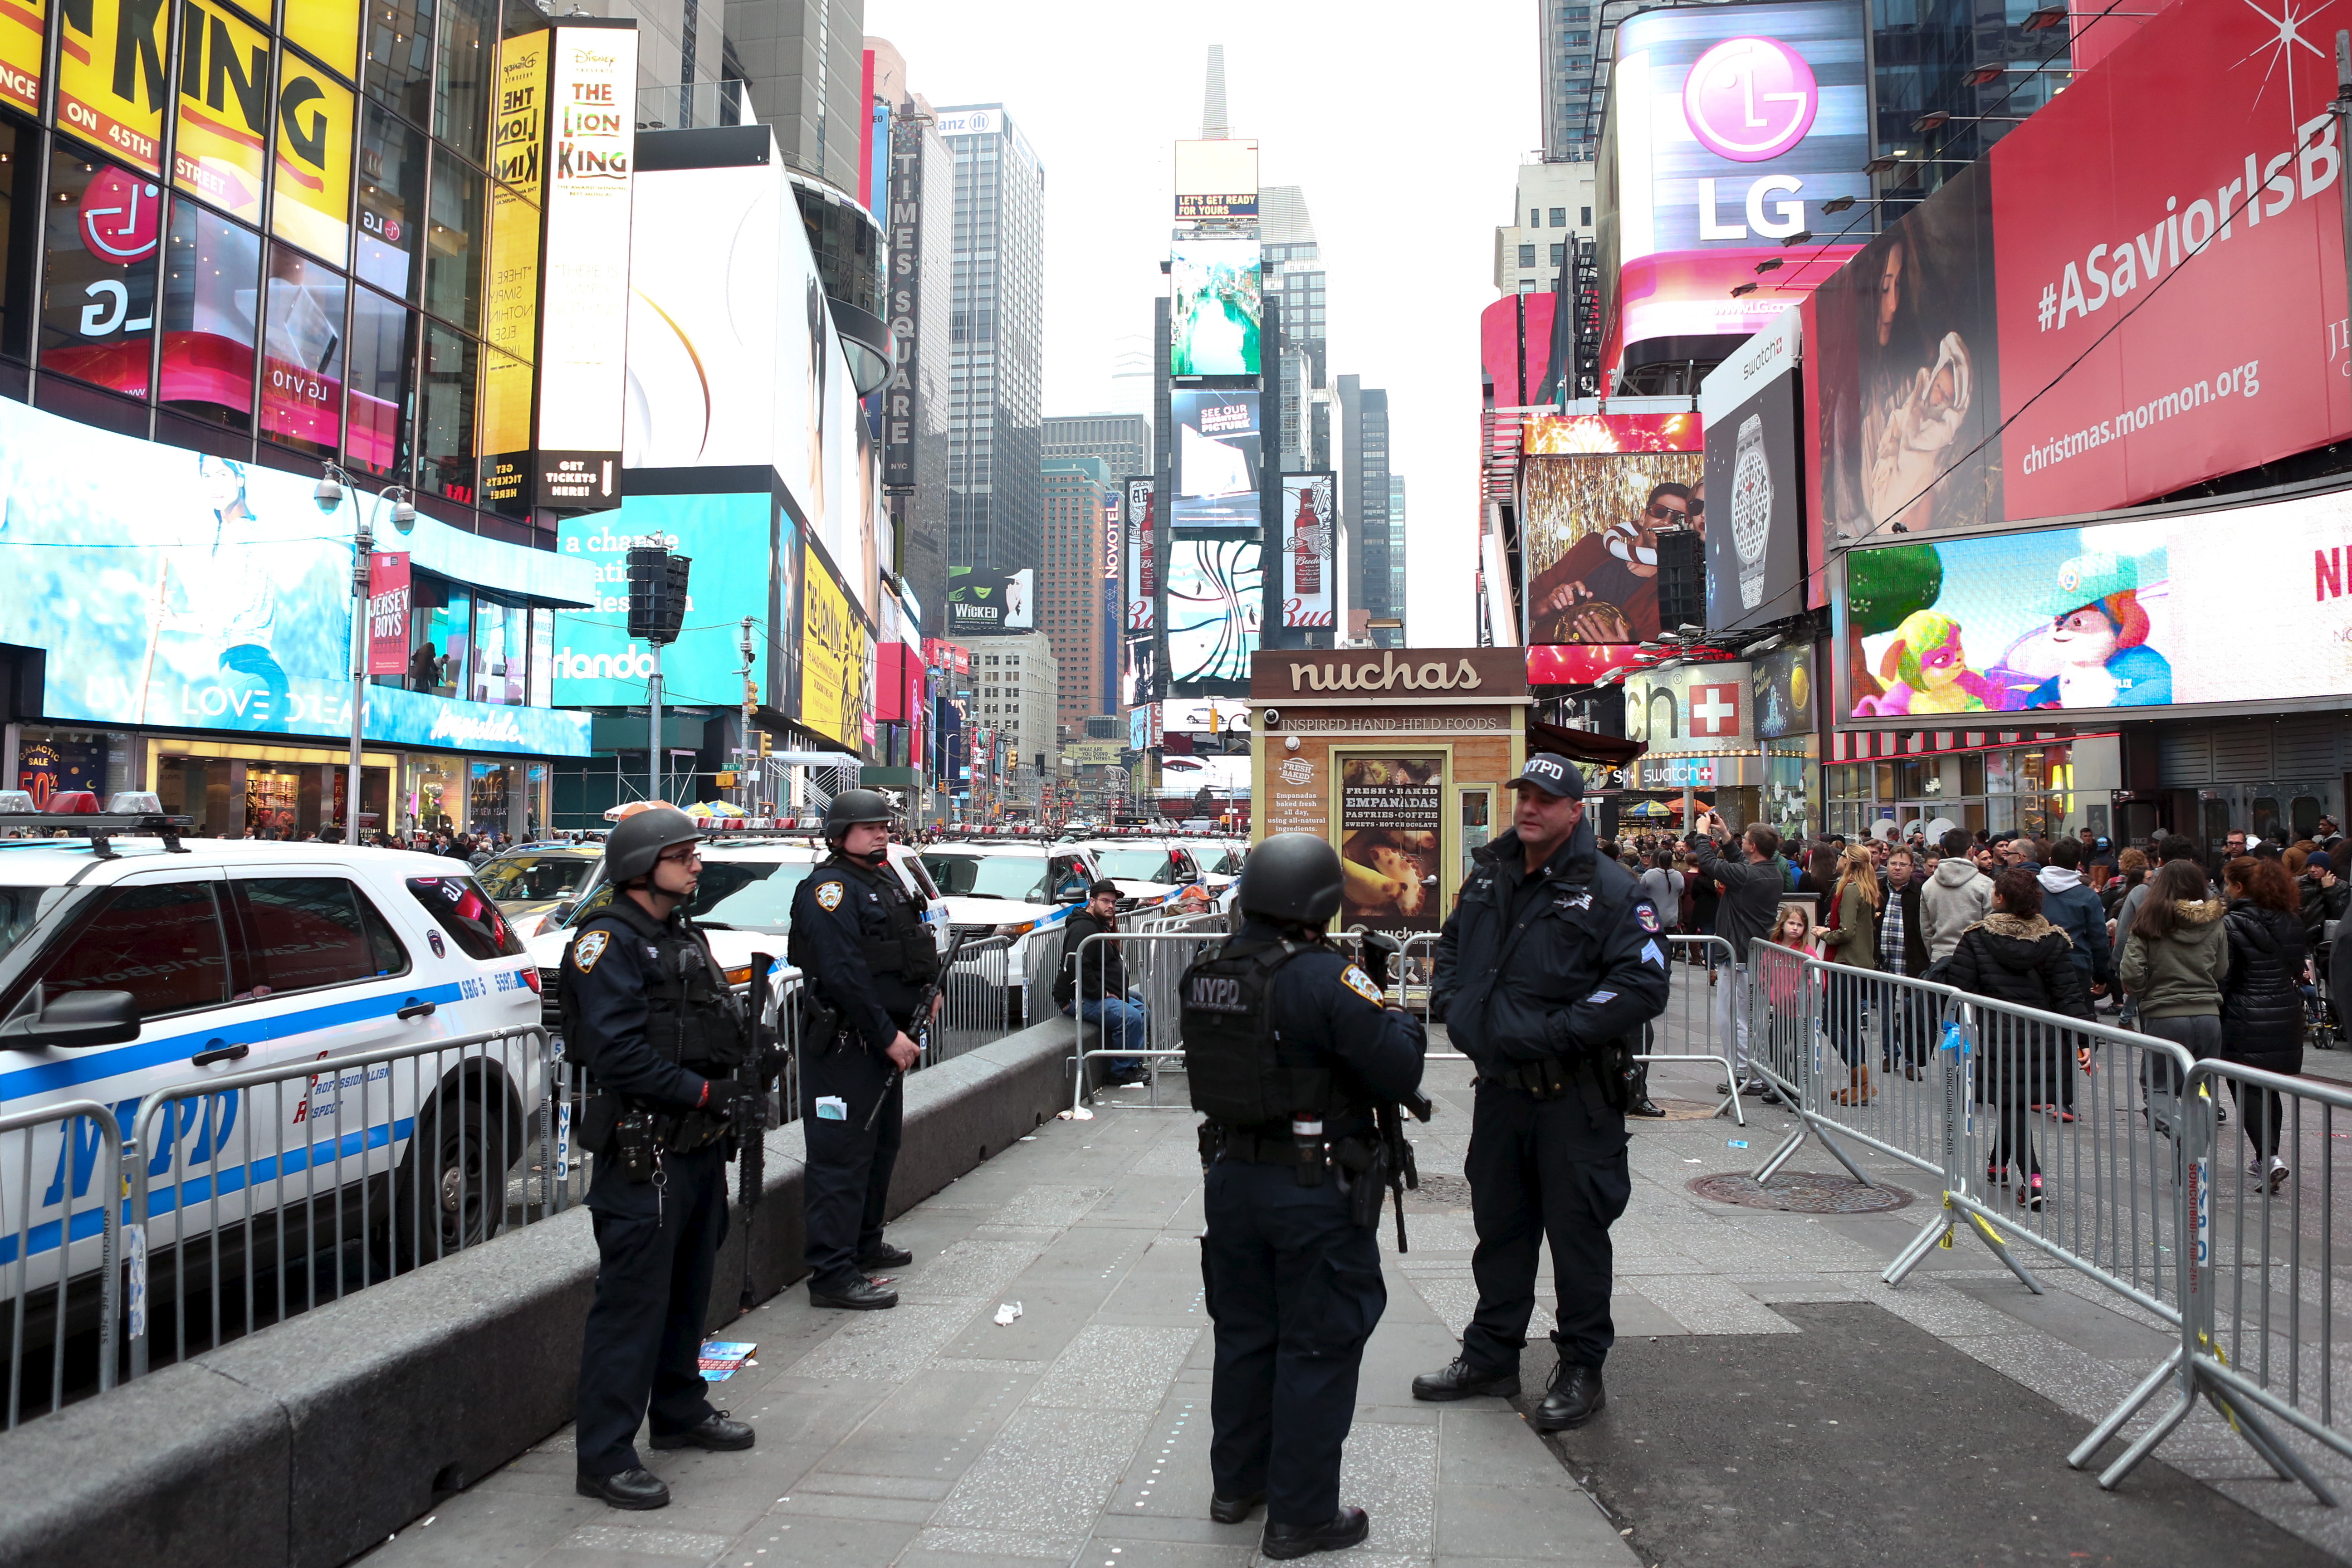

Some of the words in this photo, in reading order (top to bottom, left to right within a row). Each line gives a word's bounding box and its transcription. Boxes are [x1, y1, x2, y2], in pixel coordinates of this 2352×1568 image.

[112, 0, 328, 171] KING
[572, 83, 611, 101] THE
[939, 119, 965, 131] anz
[67, 103, 96, 131] ON
[109, 125, 152, 159] 45TH
[176, 159, 225, 195] STREET
[1179, 195, 1203, 205] LET'S
[1206, 195, 1223, 205] GET
[1226, 195, 1256, 205] READY
[1179, 205, 1196, 215] FOR
[1198, 205, 1229, 215] YOURS
[1698, 175, 1805, 240] LG
[894, 154, 917, 275] TIMES
[2038, 112, 2342, 332] #ASaviorIsB
[891, 291, 915, 444] SQUARE
[1743, 340, 1776, 380] swatch
[1201, 407, 1220, 418] SEE
[1223, 403, 1247, 415] OUR
[1201, 413, 1248, 424] BRIGHTEST
[2023, 360, 2259, 476] christmas.mormon.org
[559, 461, 584, 471] GET
[546, 473, 597, 483] TICKETS
[552, 486, 589, 496] HERE!
[1105, 500, 1119, 579] NOVOTEL
[370, 588, 409, 618] JERSEY
[807, 580, 817, 626] THE
[374, 612, 402, 638] BOYS
[1291, 651, 1482, 691] nuchas
[182, 685, 271, 721] LOVE
[1282, 719, 1347, 731] INSPIRED
[1351, 719, 1441, 731] HAND-HELD
[1445, 718, 1496, 730] FOODS
[19, 744, 60, 762] GALACTIC
[28, 757, 49, 766] SALE
[1282, 770, 1310, 780] BAKED
[1283, 763, 1311, 773] FRESH
[1522, 759, 1563, 780] NYPD
[1644, 764, 1699, 782] swatch
[1346, 798, 1438, 808] EMPANADAS
[462, 979, 479, 1000] SRG
[479, 977, 486, 995] 5
[494, 972, 513, 992] 5597
[1193, 977, 1239, 1005] NYPD
[558, 1105, 569, 1177] NYPD
